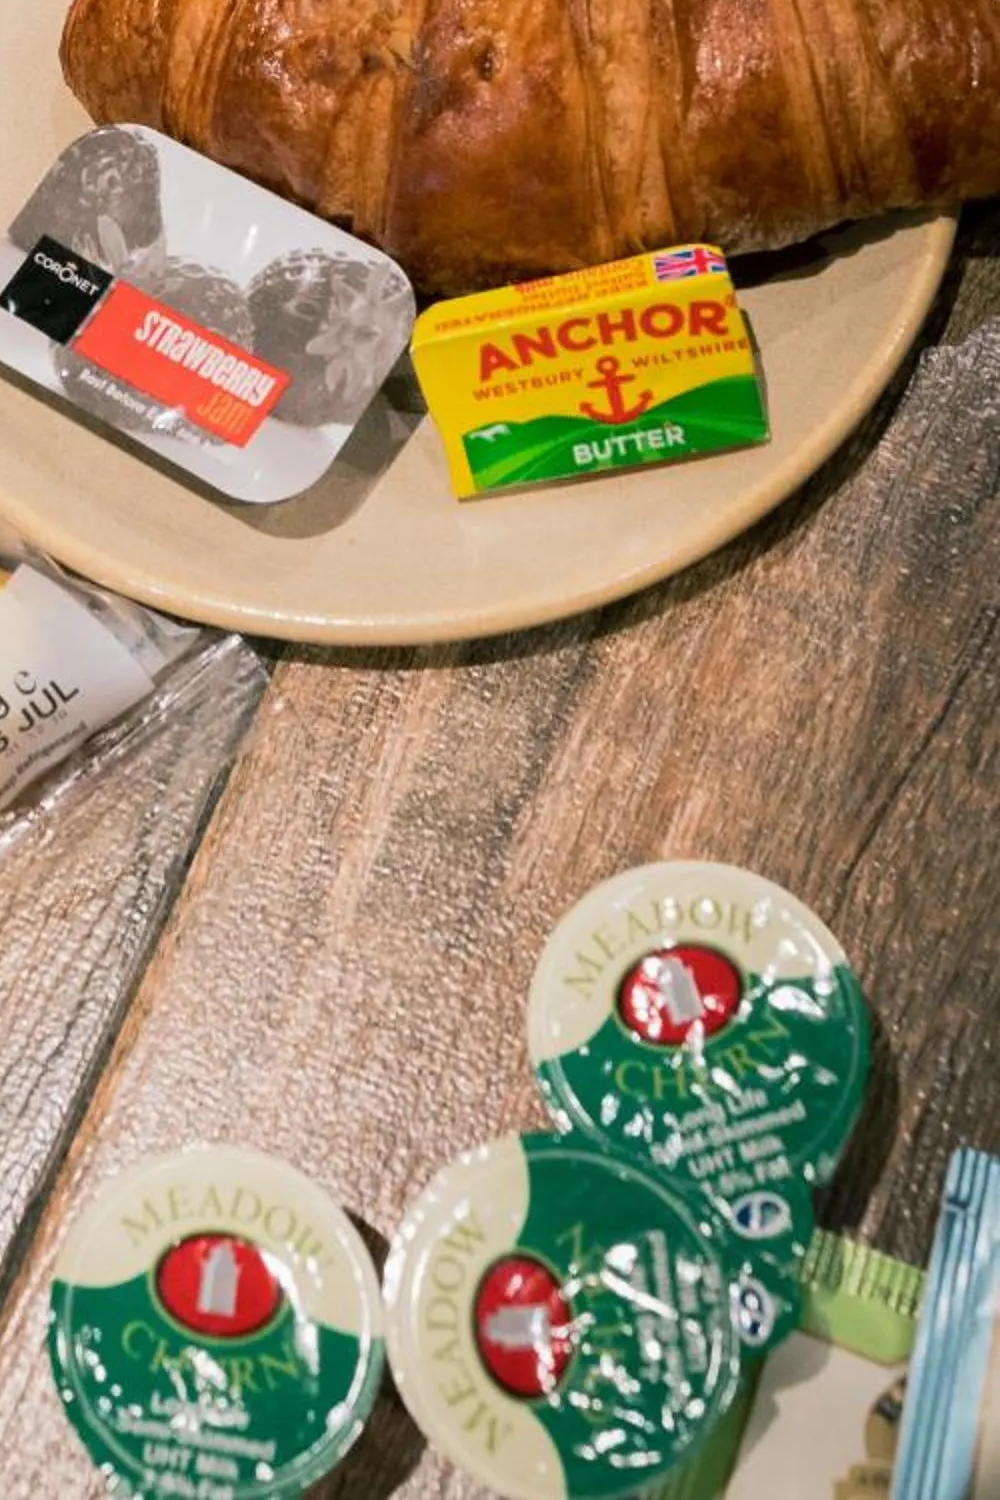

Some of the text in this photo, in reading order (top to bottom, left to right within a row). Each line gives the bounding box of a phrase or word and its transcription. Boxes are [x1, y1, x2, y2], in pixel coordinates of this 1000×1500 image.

[34, 250, 99, 297] CORONET
[472, 338, 750, 401] WESTBURY WILTSHIRE
[478, 301, 729, 382] ANCHOR
[572, 424, 686, 465] BUTTER
[17, 680, 79, 733] JUL
[426, 1213, 515, 1453] MEADOW
